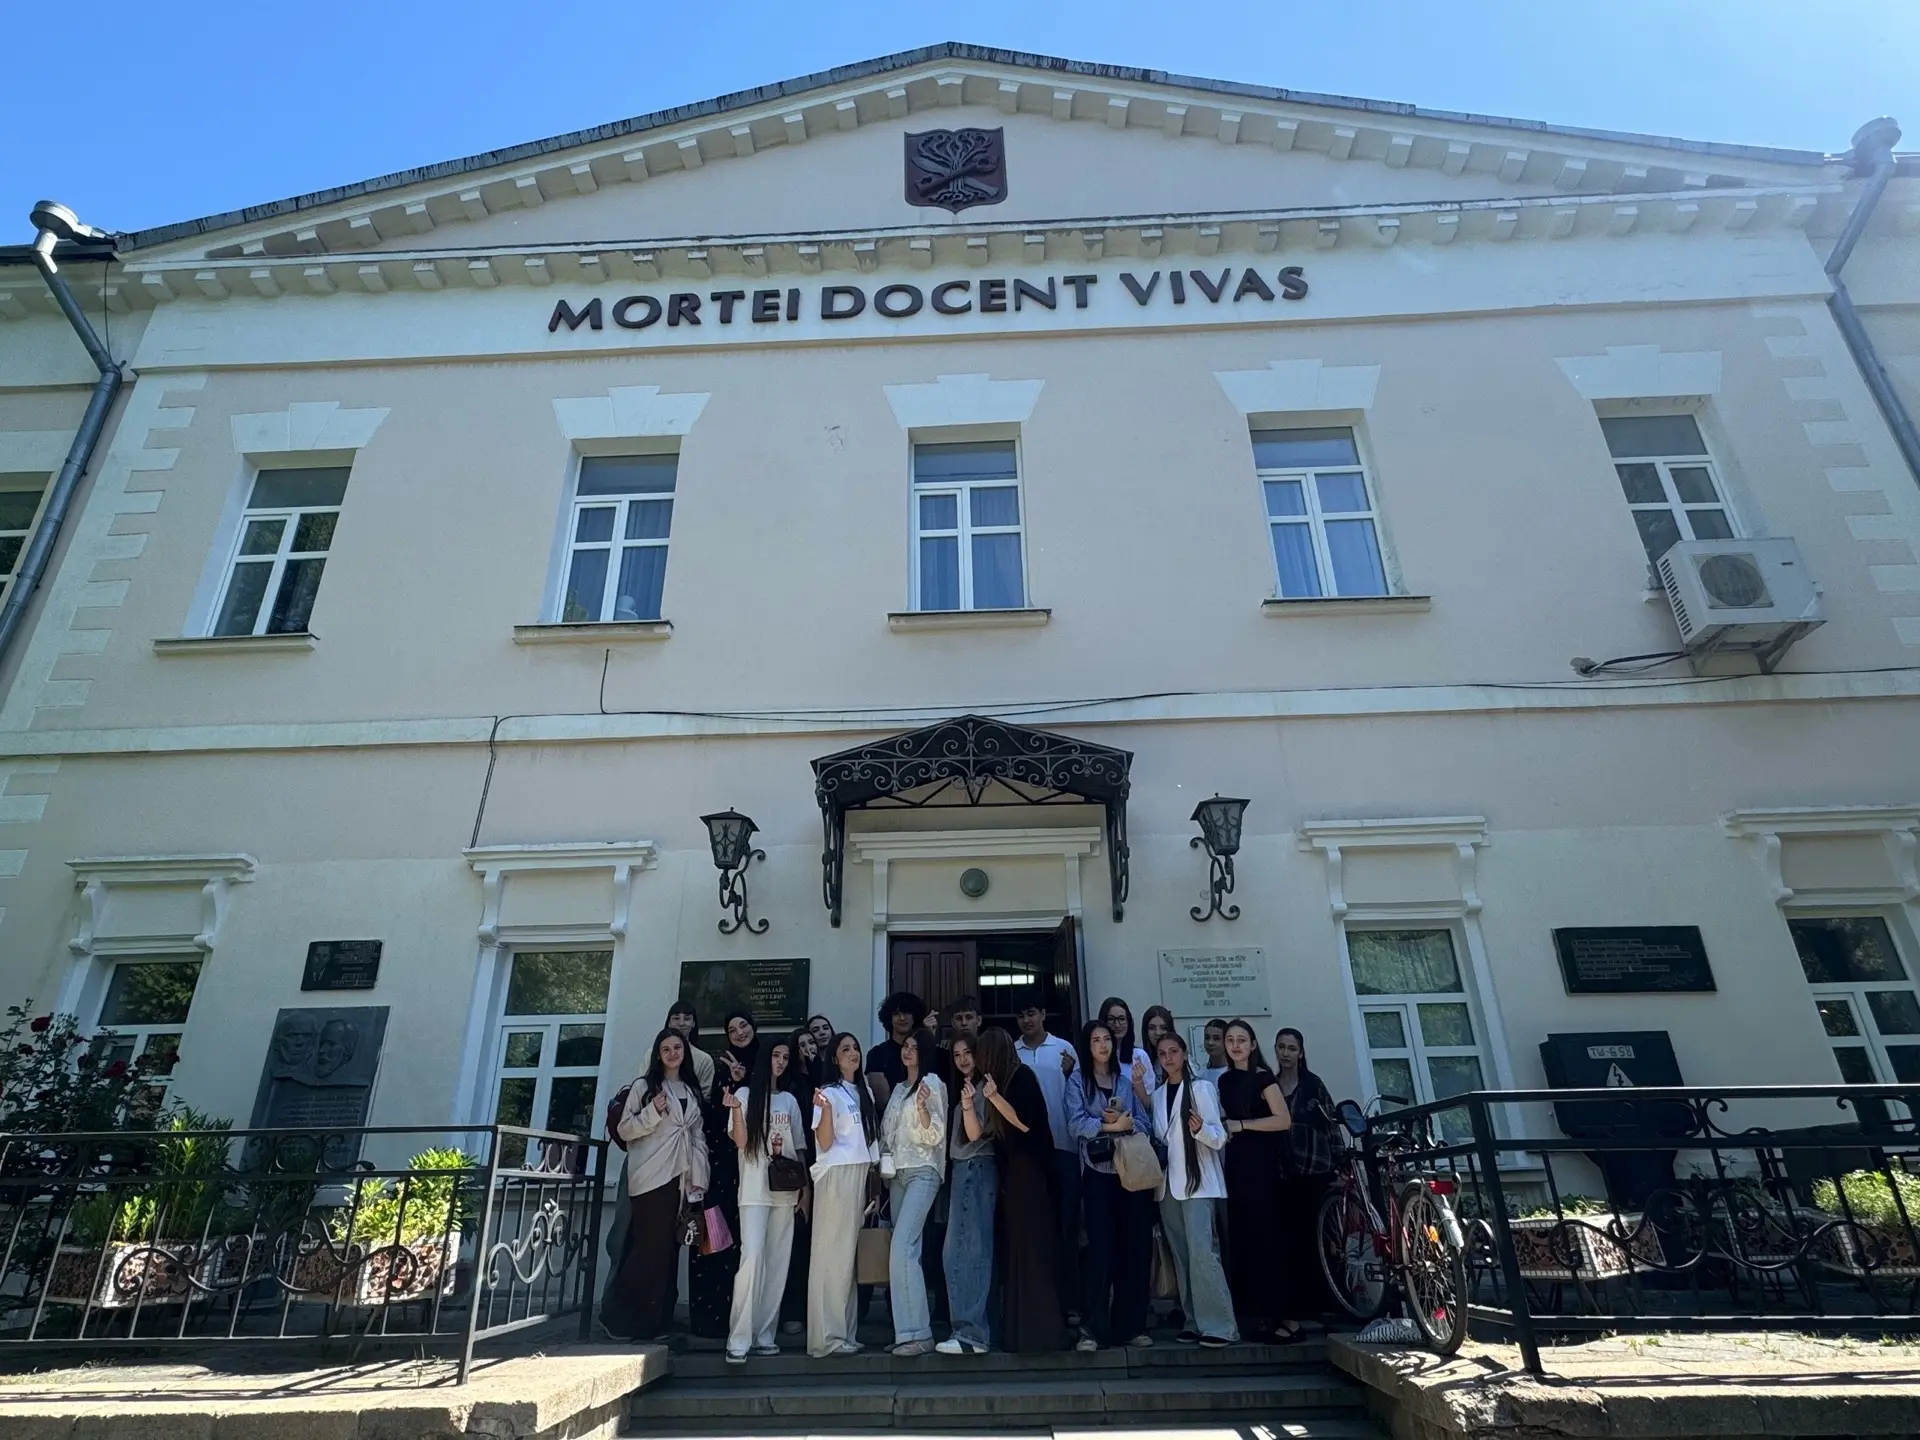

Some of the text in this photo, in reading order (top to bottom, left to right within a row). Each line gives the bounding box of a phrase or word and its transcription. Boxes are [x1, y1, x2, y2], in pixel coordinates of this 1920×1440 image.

[548, 266, 1309, 332] MORTEI DOCENT VIVAS
